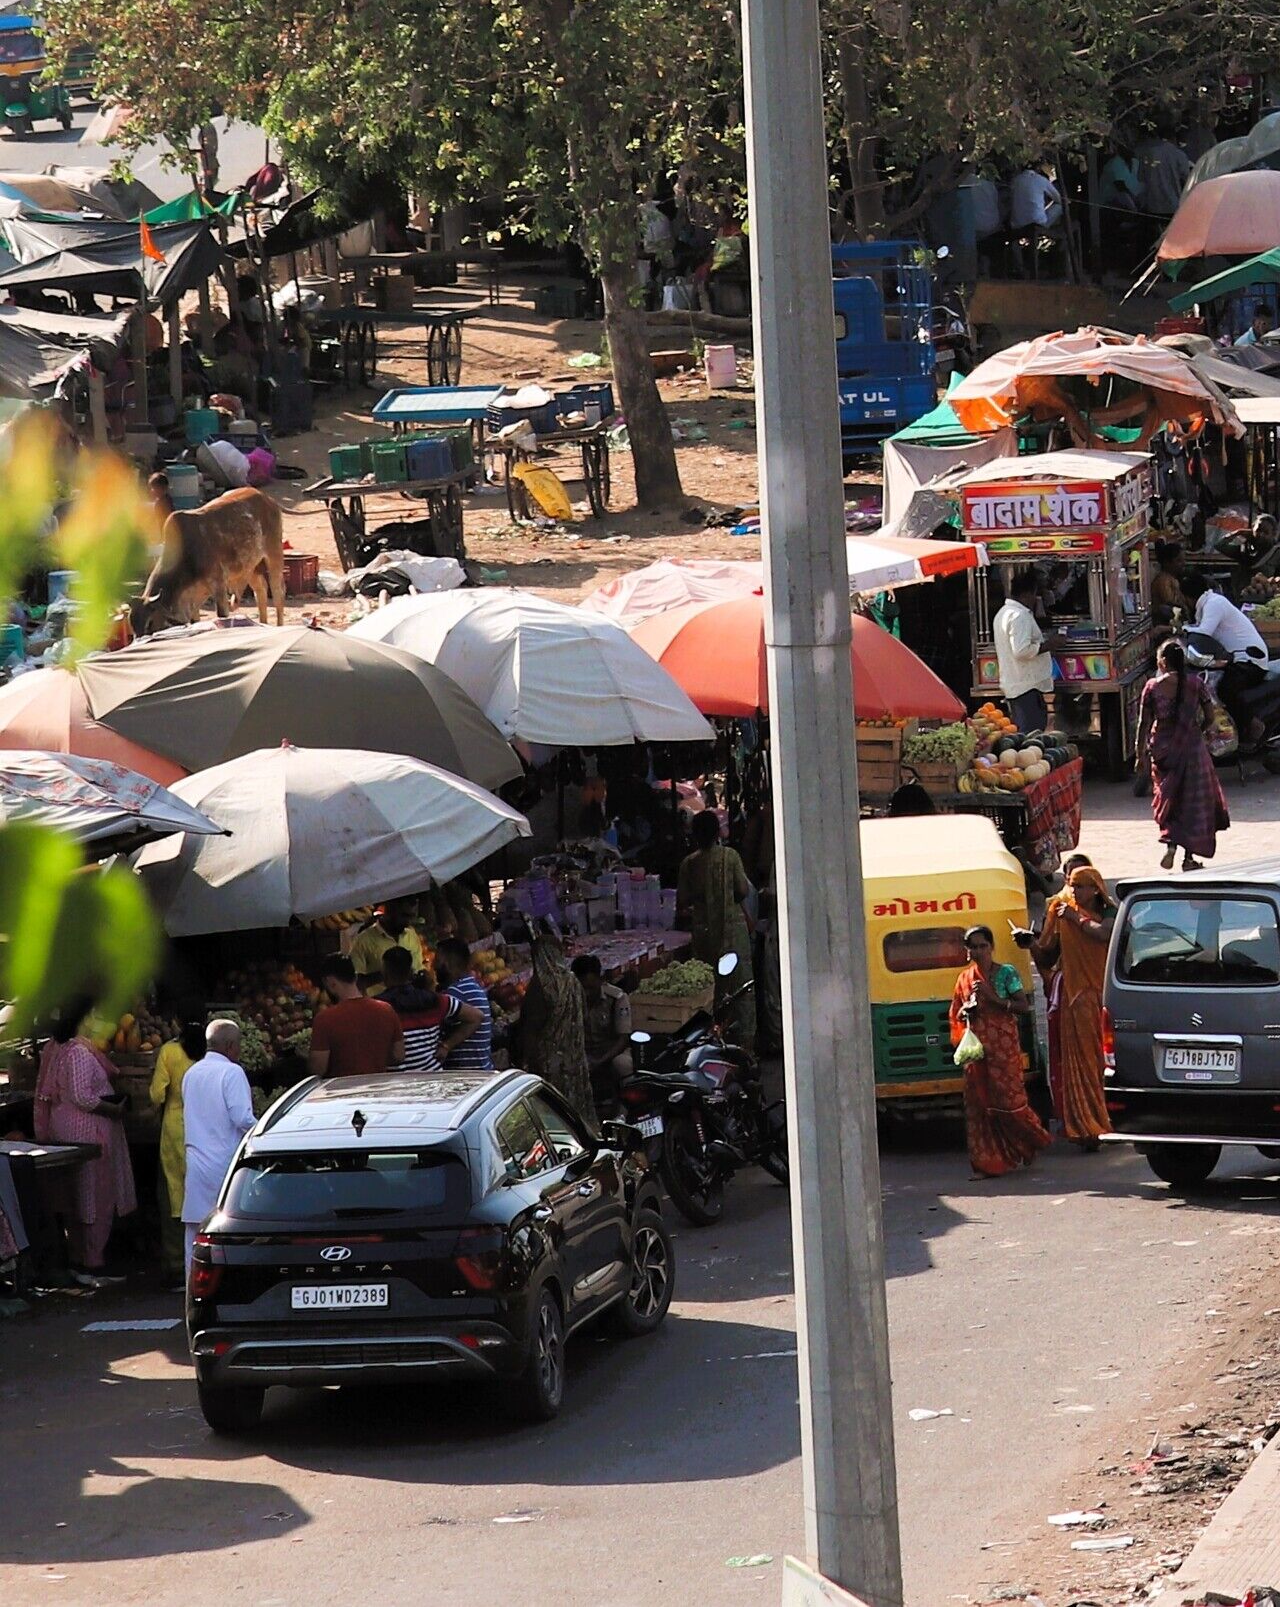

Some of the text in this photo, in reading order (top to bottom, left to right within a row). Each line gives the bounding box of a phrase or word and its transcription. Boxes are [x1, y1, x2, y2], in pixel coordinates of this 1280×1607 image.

[966, 494, 1041, 529] बादाम
[1044, 486, 1100, 527] शेक
[1171, 1052, 1235, 1067] GJ18BJ1218
[279, 1264, 393, 1274] CRETA
[302, 1288, 386, 1305] GJ01WD2389
